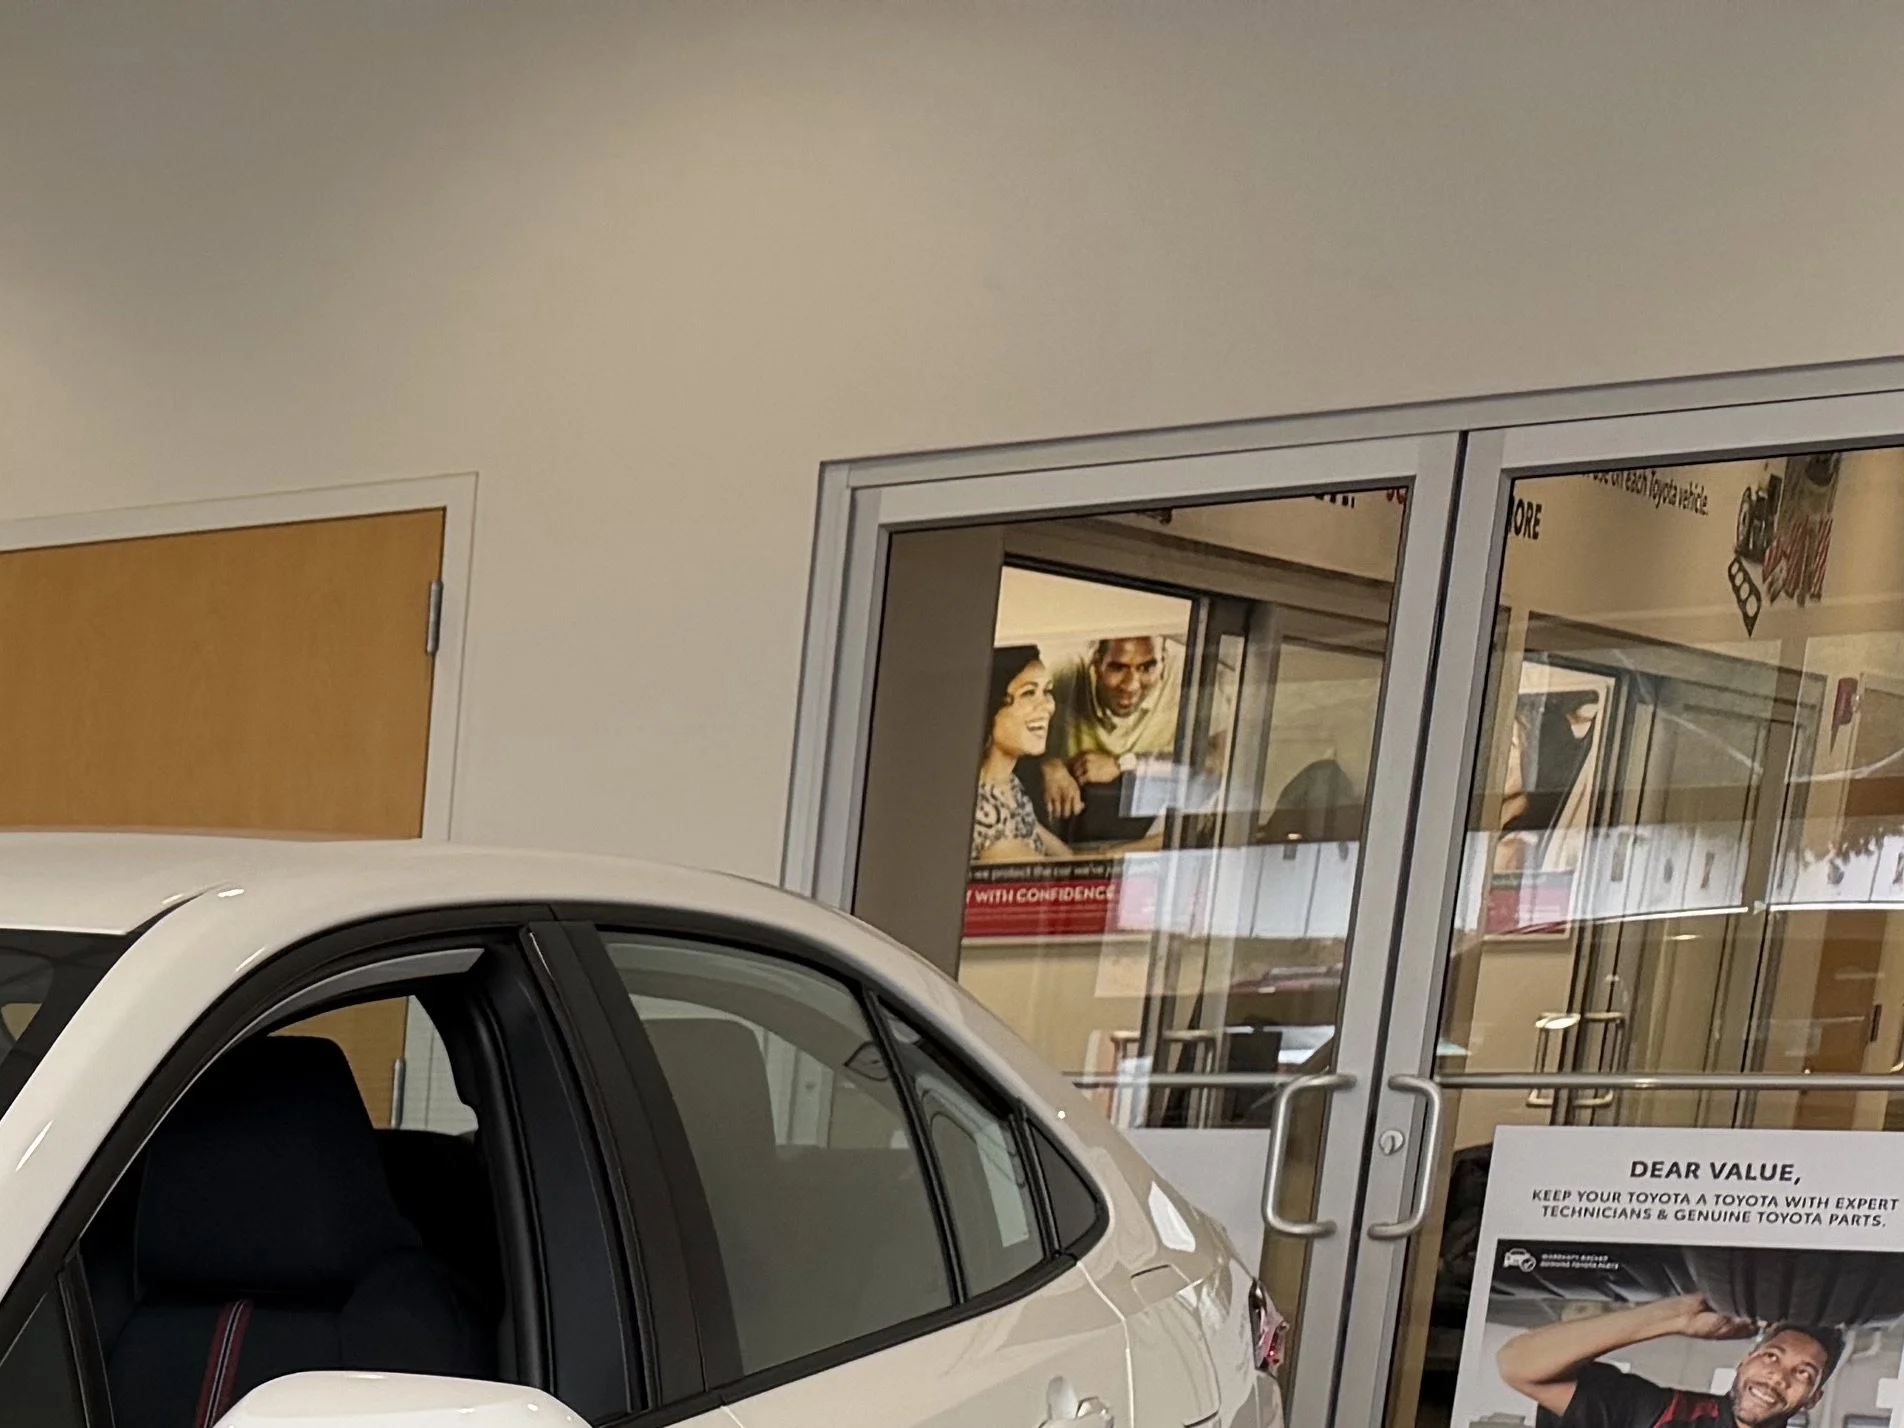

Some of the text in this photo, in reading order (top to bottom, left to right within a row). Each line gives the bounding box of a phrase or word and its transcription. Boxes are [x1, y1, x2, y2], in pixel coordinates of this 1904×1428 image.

[1625, 469, 1648, 496] each
[1649, 470, 1677, 509] Toyota
[1678, 482, 1709, 516] vehicle.
[1509, 495, 1542, 540] ORE
[975, 888, 1014, 905] WITH
[1629, 1160, 1802, 1186] DEAR VALUE,
[1532, 1189, 1900, 1212] KEEP YOUR TOYOTA A TOYOTA WITH EXPERT
[1541, 1205, 1887, 1228] TECHNICIANS & GENUINE TOYOTA PARTS.
